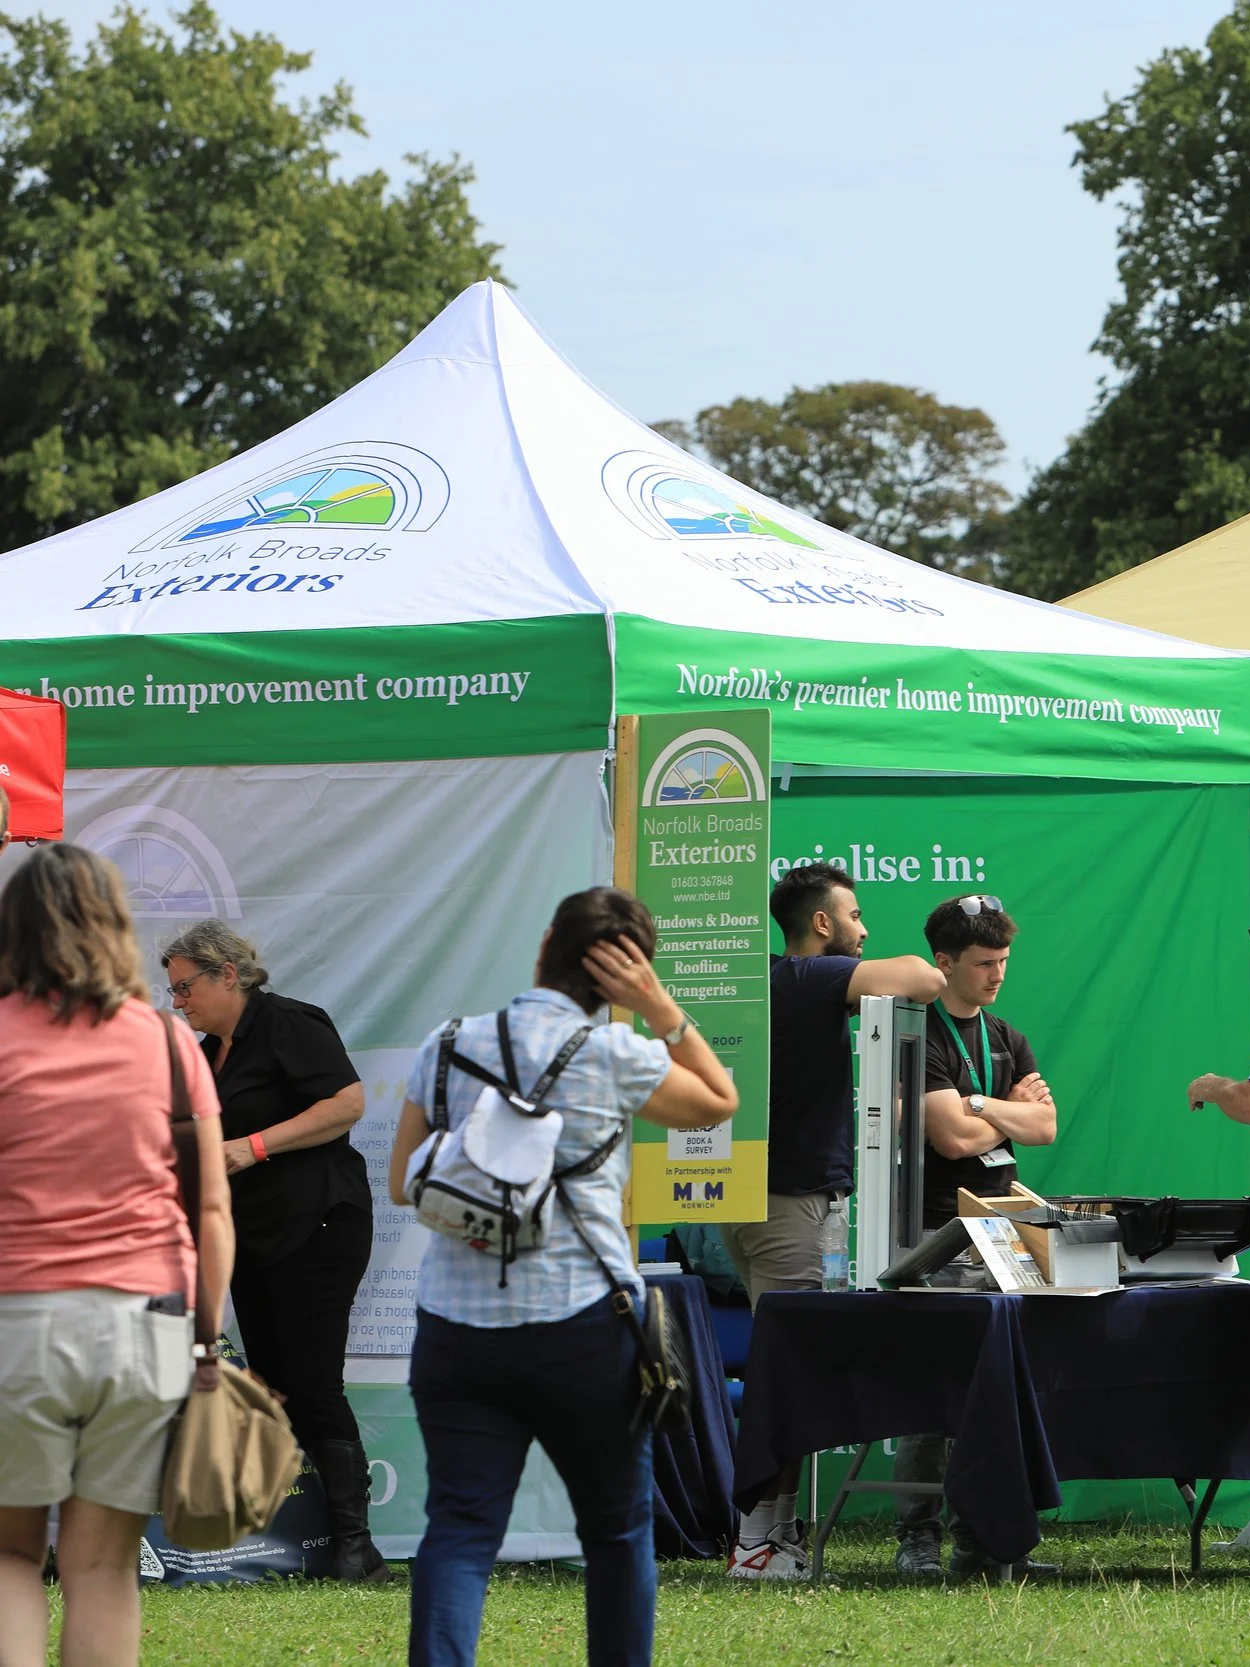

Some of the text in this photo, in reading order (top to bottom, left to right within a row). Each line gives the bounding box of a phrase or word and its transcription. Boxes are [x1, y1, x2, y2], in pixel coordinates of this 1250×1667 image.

[103, 538, 392, 582] Norfolk Broads
[681, 550, 802, 572] Norfolk
[75, 565, 345, 611] Exteriors
[731, 577, 945, 618] Exteriors
[40, 667, 532, 713] home improvement company
[793, 676, 892, 712] premier
[896, 678, 963, 713] home
[967, 681, 1125, 725] improvement
[1129, 699, 1222, 736] company
[643, 814, 764, 836] Norfolk Broads
[649, 838, 757, 867] Exteriors
[930, 843, 986, 883] in:
[671, 874, 734, 889] 01603 367848
[673, 889, 731, 903] www.nbe.ltd
[706, 912, 718, 928] &
[720, 911, 760, 927] Doors
[655, 936, 751, 954] Conservatories
[674, 960, 729, 975] Roofline
[666, 982, 738, 1000] Orangeries
[712, 1036, 744, 1047] ROOF
[686, 1137, 713, 1145] BOOK A
[685, 1146, 713, 1155] SURVEY
[665, 1166, 733, 1177] In Partnership with
[673, 1181, 724, 1202] MKM
[681, 1202, 716, 1210] NORWICH
